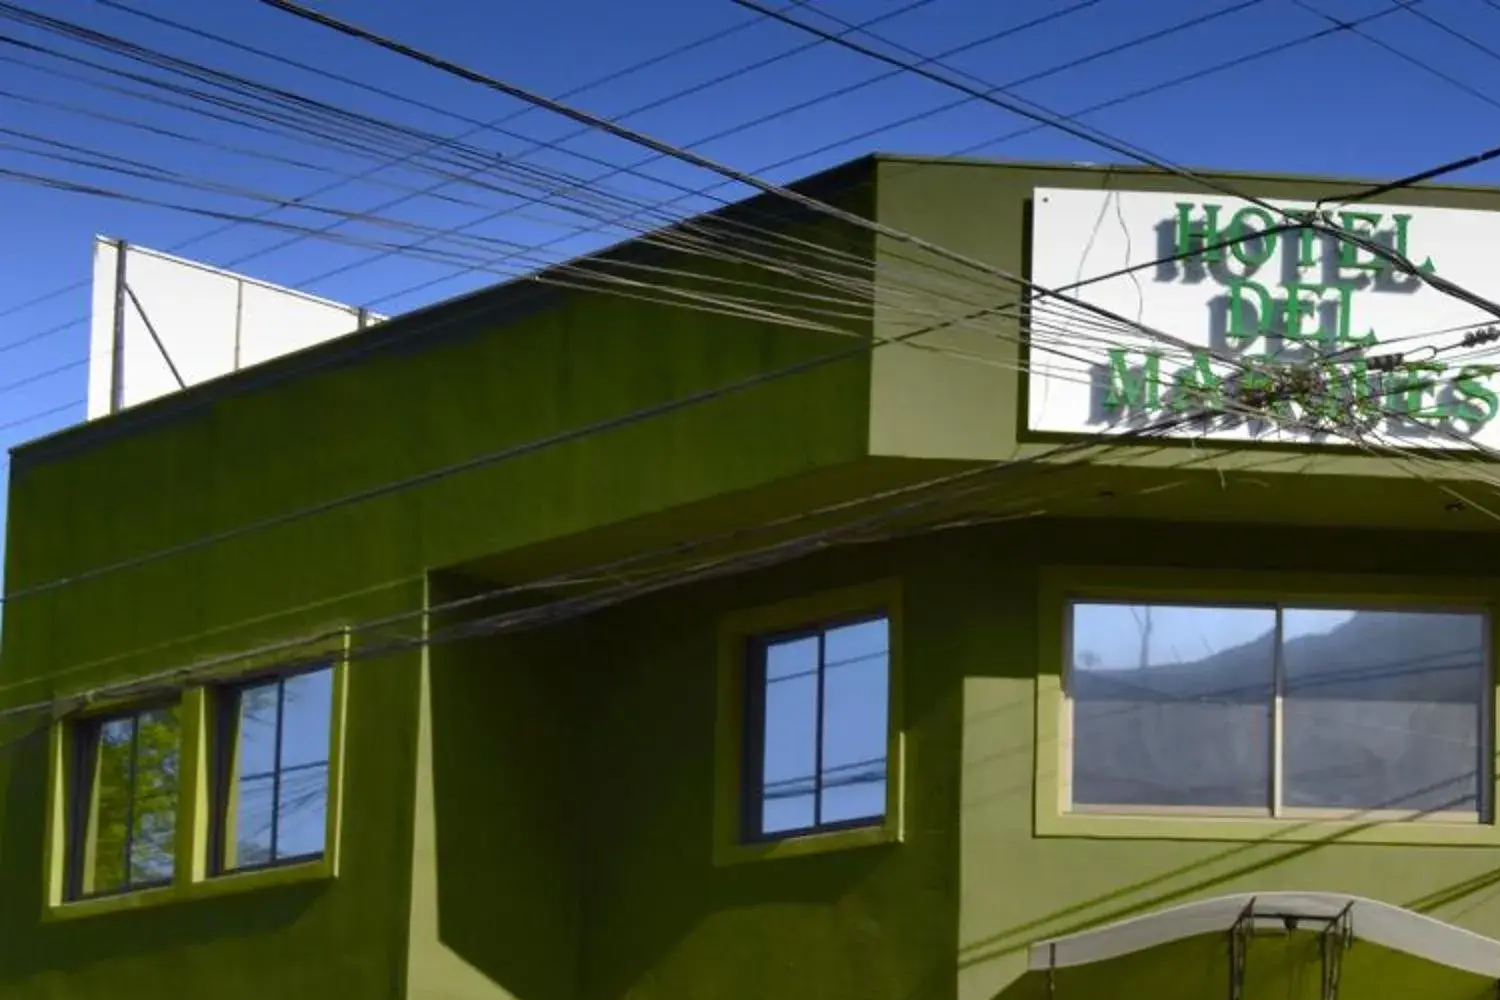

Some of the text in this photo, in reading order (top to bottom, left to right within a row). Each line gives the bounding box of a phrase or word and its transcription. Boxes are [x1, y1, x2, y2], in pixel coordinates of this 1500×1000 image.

[1175, 203, 1436, 273] HOTEL
[1226, 275, 1379, 346] DEL
[1104, 347, 1499, 424] MAUES
